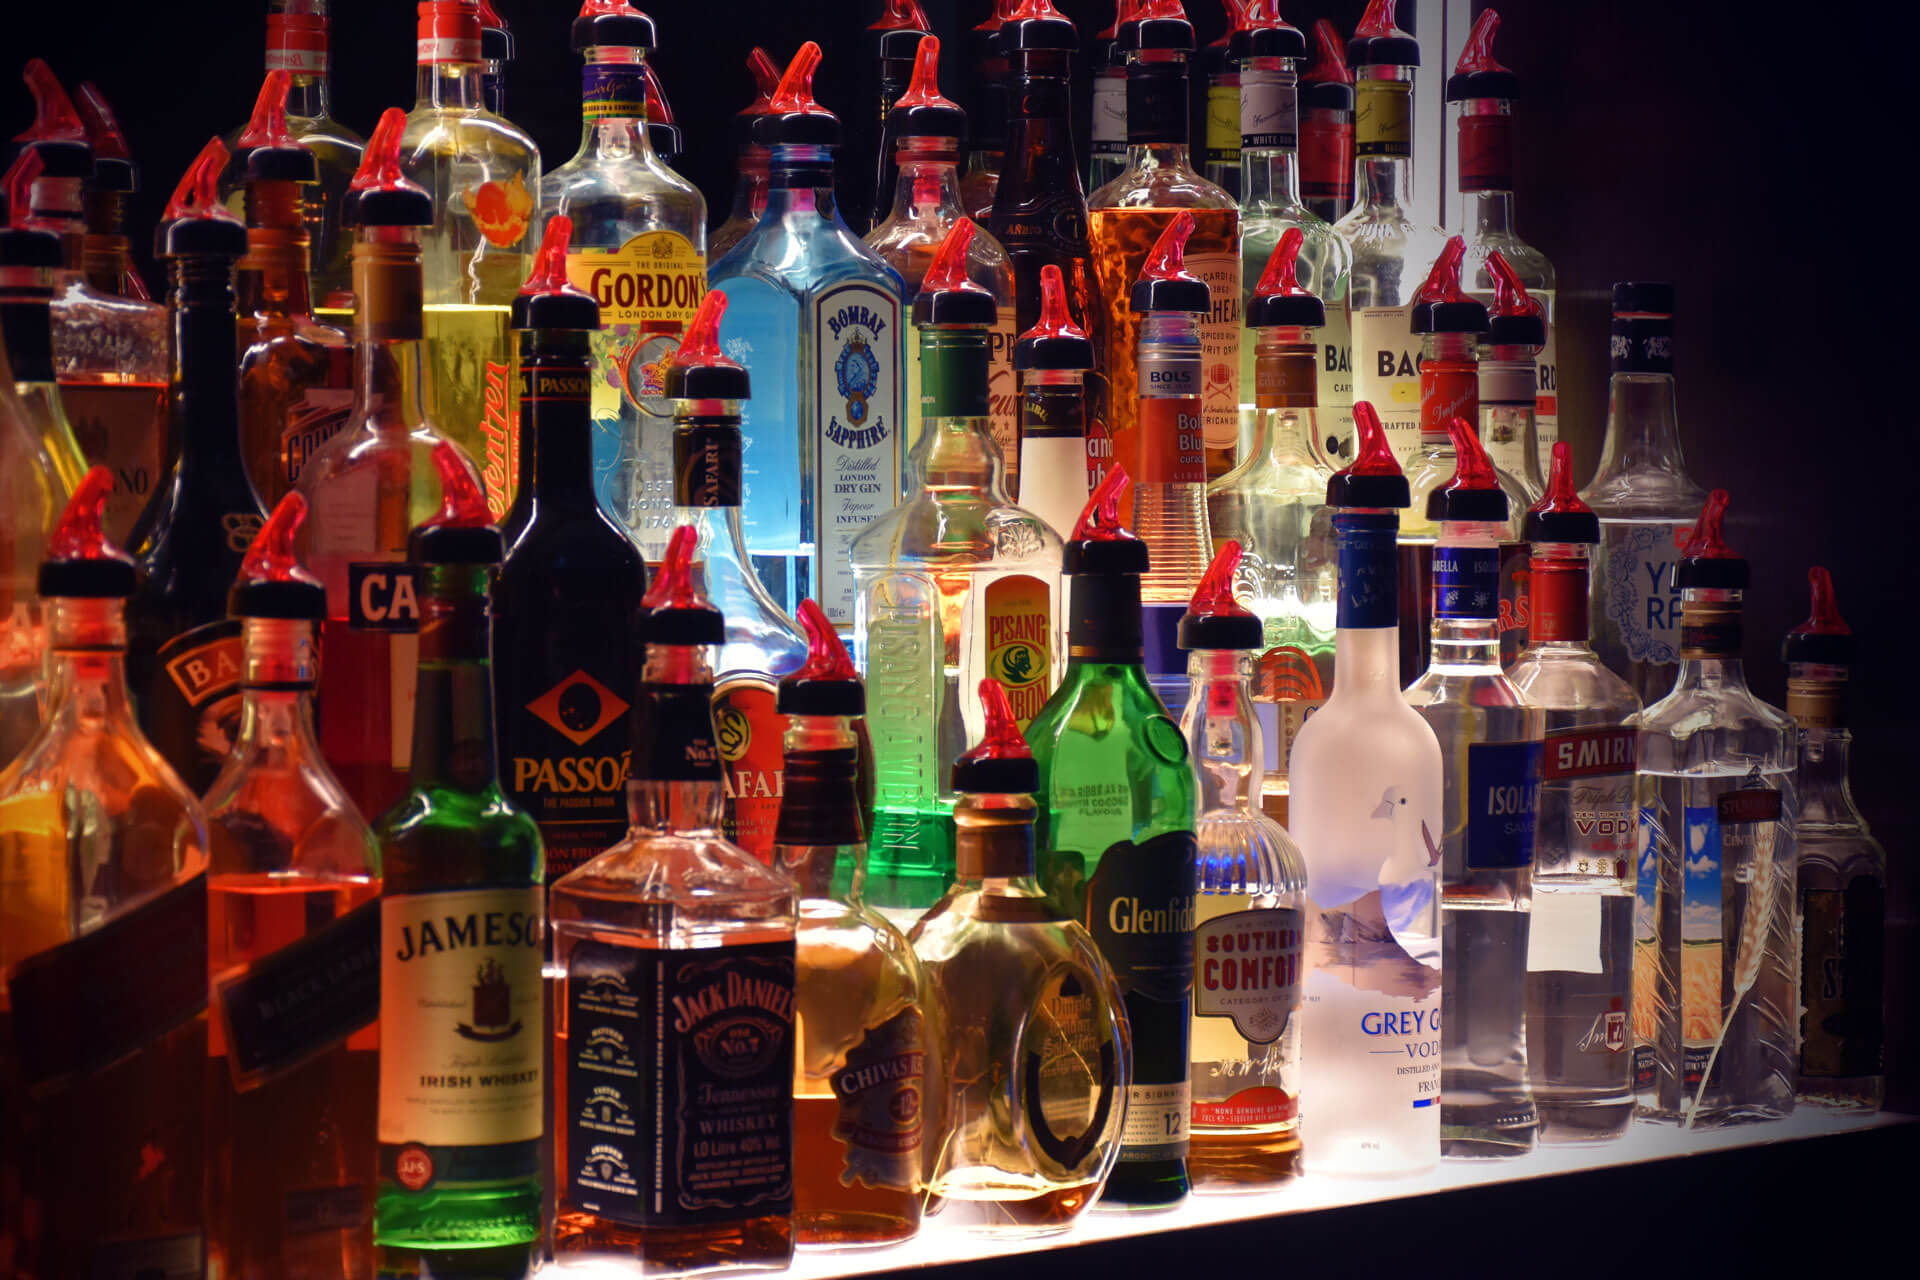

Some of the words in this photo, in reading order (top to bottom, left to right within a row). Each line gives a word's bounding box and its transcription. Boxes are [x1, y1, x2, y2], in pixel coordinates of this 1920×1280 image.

[618, 311, 662, 319] LONDON
[666, 311, 682, 319] DRY
[827, 306, 887, 341] BOMBAY
[1150, 371, 1192, 383] BOLS
[825, 416, 889, 450] SAPPHIRE
[1178, 434, 1204, 451] Blu
[704, 444, 719, 507] SAFARI
[840, 474, 876, 482] LONDON
[834, 484, 857, 493] DRY
[860, 483, 882, 493] GIN
[990, 613, 1046, 652] PISANG
[1557, 735, 1637, 770] SMIRN
[672, 983, 726, 1033] JACK
[1220, 996, 1269, 1006] CATEGORY
[1361, 1010, 1425, 1036] GREY
[420, 1073, 472, 1089] IRISH
[841, 1057, 907, 1095] CHIVAS
[1396, 1065, 1430, 1075] DISTILLED
[699, 1113, 778, 1136] WHISKEY
[1164, 1112, 1182, 1136] 12
